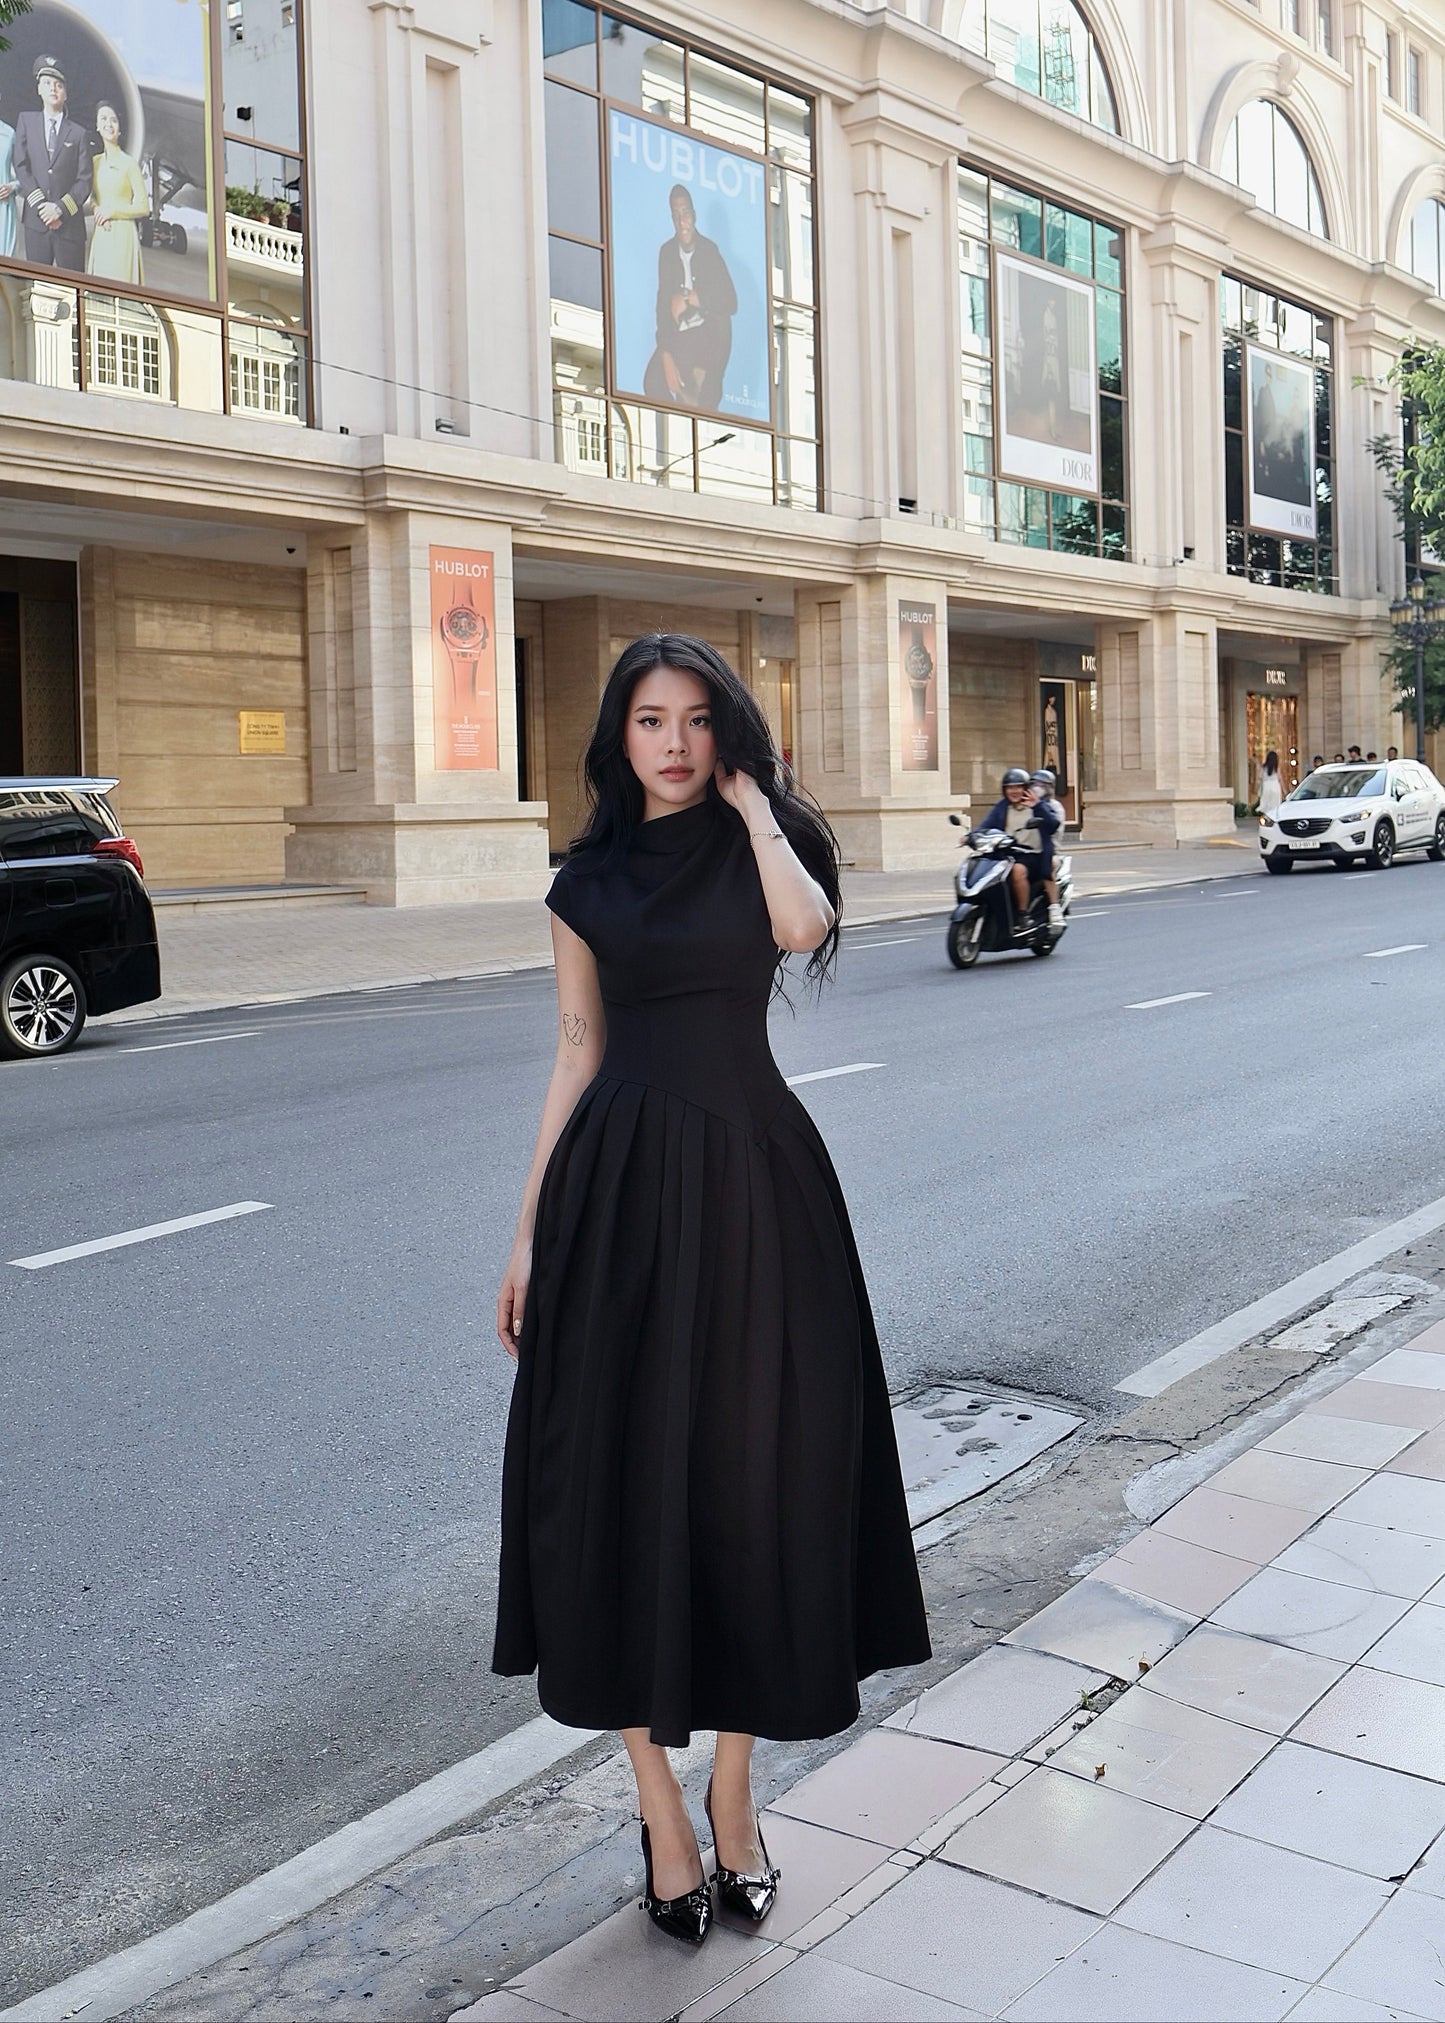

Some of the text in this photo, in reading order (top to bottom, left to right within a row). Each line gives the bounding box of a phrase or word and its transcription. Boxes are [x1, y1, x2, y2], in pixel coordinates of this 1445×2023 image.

[611, 115, 762, 205] HUBLOT
[1062, 457, 1093, 482] DIOR
[434, 559, 489, 579] HUBLOT
[900, 610, 934, 625] HUBLOT
